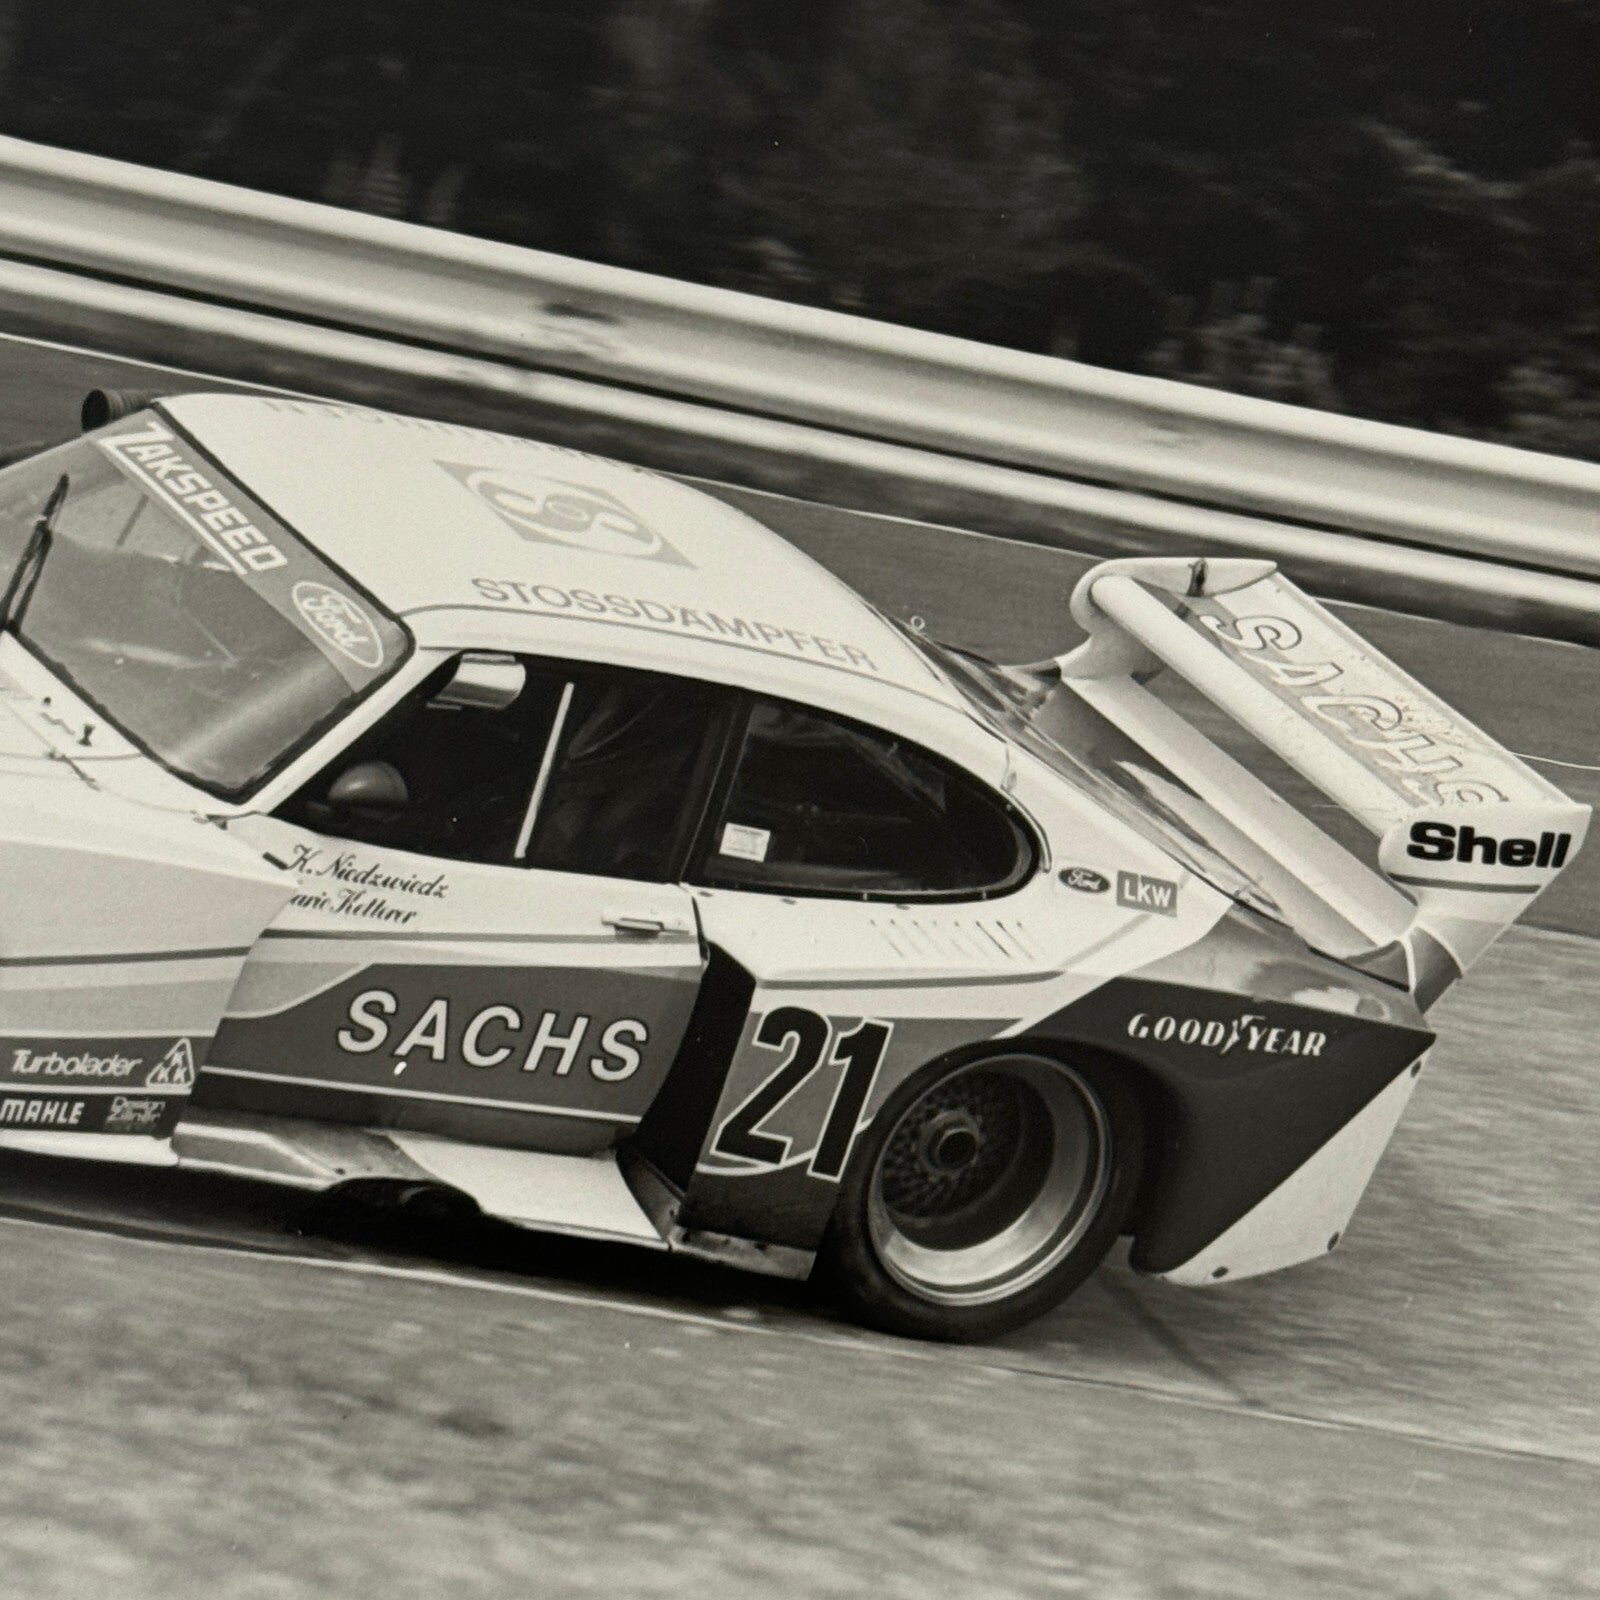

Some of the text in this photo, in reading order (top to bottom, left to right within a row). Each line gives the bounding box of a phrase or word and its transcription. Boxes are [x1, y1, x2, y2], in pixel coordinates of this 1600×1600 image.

[101, 421, 288, 575] ZAKSPEED
[1406, 821, 1572, 868] Shell
[316, 853, 449, 899] Niedzwiedz
[1123, 875, 1172, 908] LKW
[336, 989, 648, 1083] SACHS
[1127, 1012, 1327, 1057] GOODYEAR
[12, 1049, 143, 1078] Turbolader
[0, 1098, 86, 1125] MAHLE
[709, 1004, 895, 1184] 21
